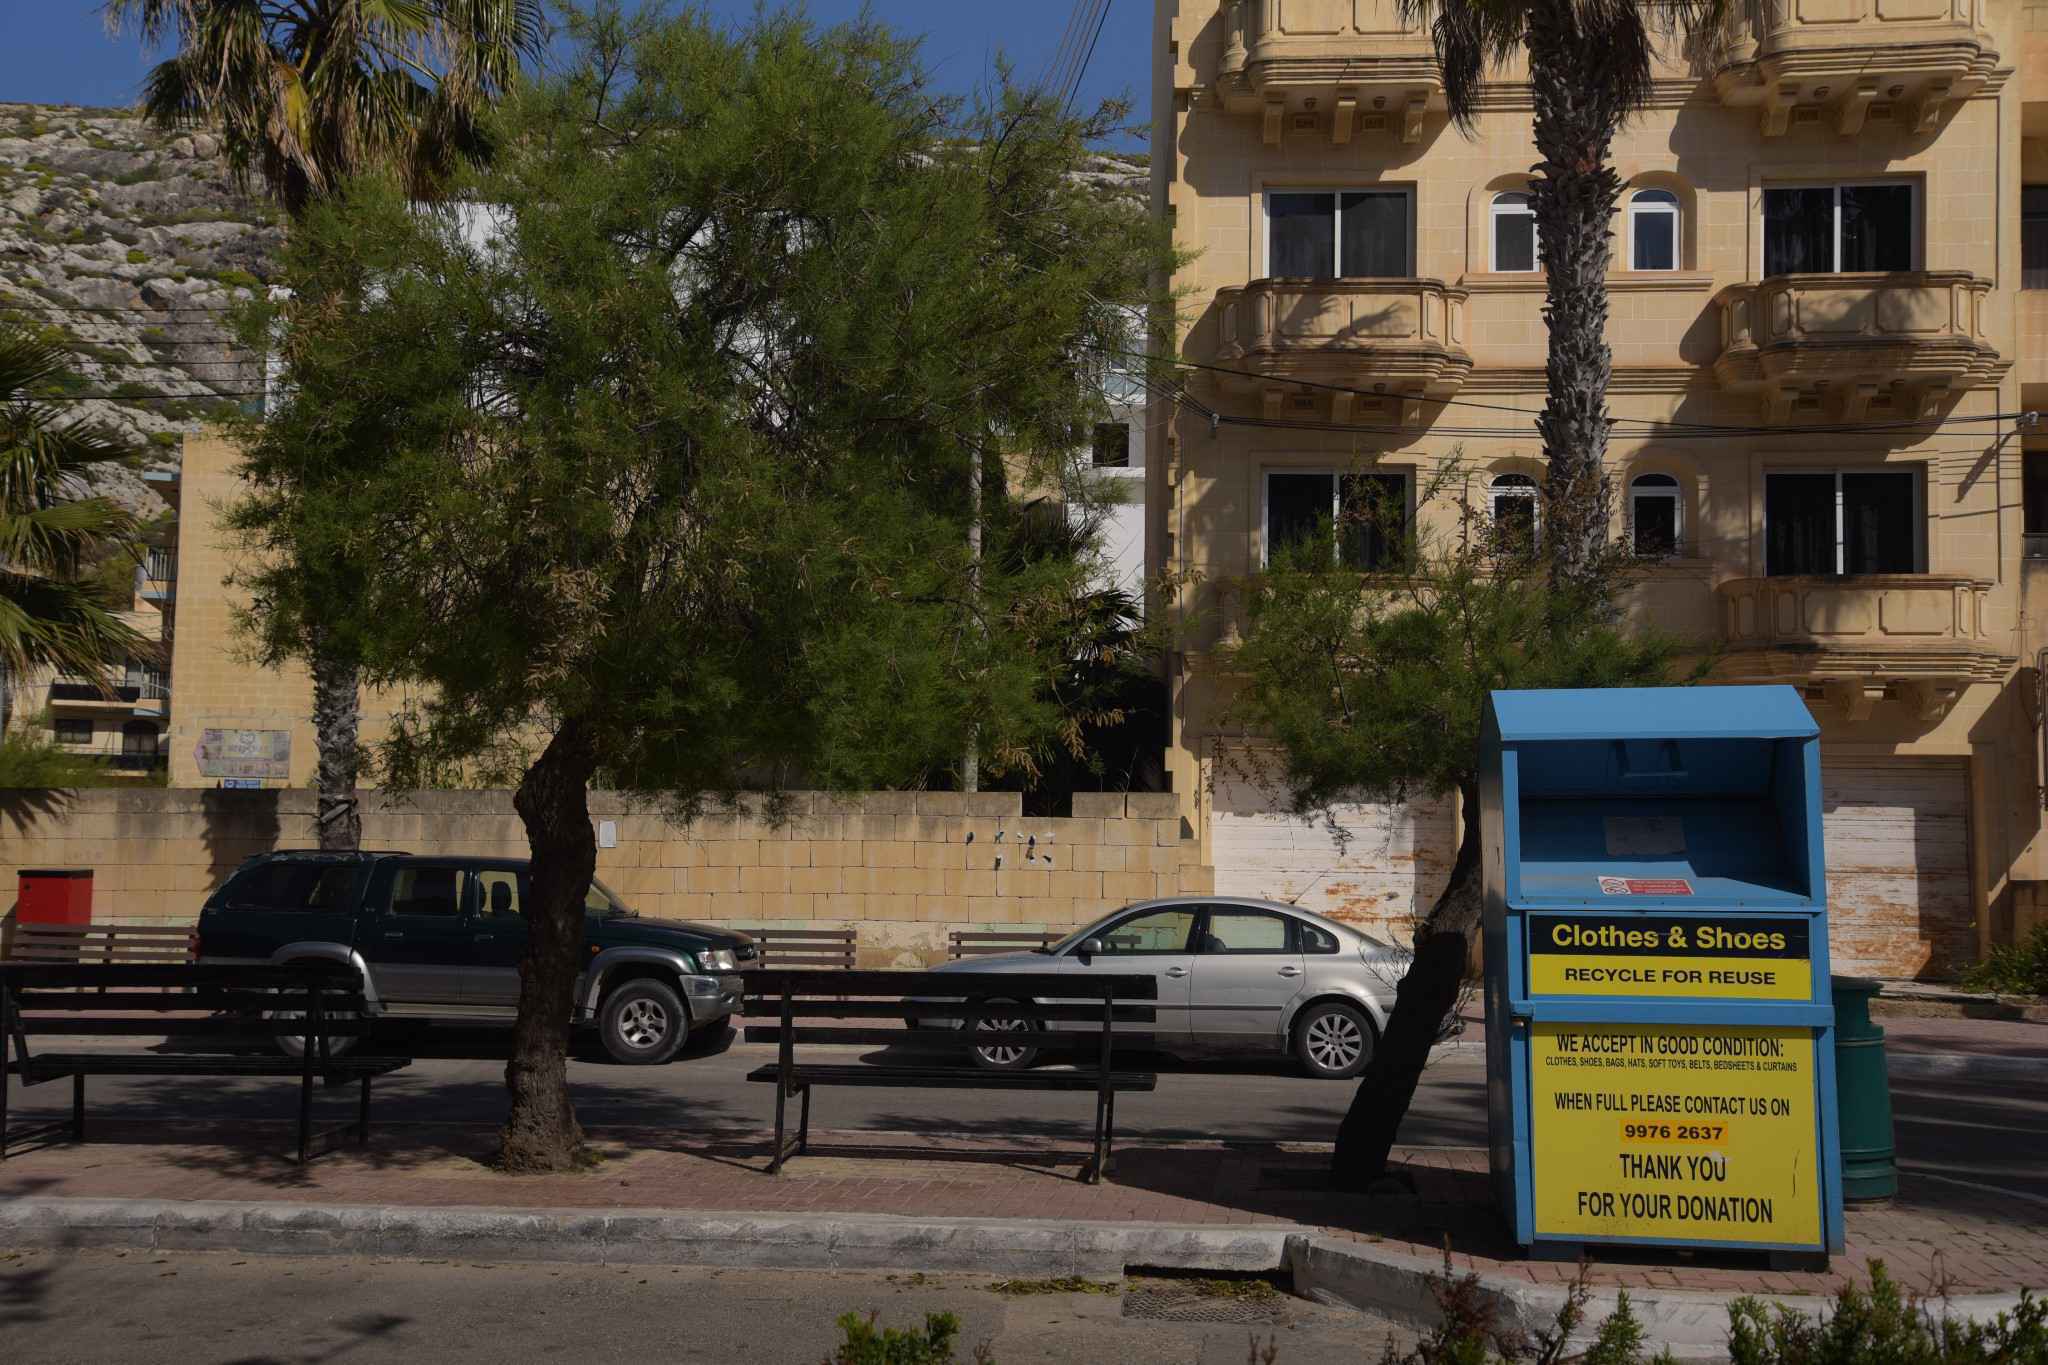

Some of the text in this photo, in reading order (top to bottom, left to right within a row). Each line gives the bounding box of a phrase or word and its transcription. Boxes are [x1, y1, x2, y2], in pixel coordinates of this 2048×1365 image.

[1552, 924, 1786, 950] Clothes & Shoes
[1565, 968, 1776, 985] RECYCLE FOR REUSE
[1556, 1033, 1784, 1056] WE ACCEPT IN GOOD CONDITION:
[1546, 1056, 1578, 1067] CLOTHES,
[1580, 1057, 1604, 1067] SHOES,
[1606, 1058, 1627, 1068] BAGS,
[1649, 1059, 1666, 1068] SOFT
[1667, 1059, 1688, 1069] TOYS,
[1689, 1060, 1712, 1070] BELTS,
[1763, 1062, 1797, 1072] CURTAINS
[1554, 1092, 1790, 1116] WHEN FULL PLEASE CONTACT US ON
[1625, 1125, 1723, 1140] 9976 2637
[1620, 1153, 1726, 1181] THANK YOU
[1578, 1192, 1772, 1223] FOR YOUR DONATION
